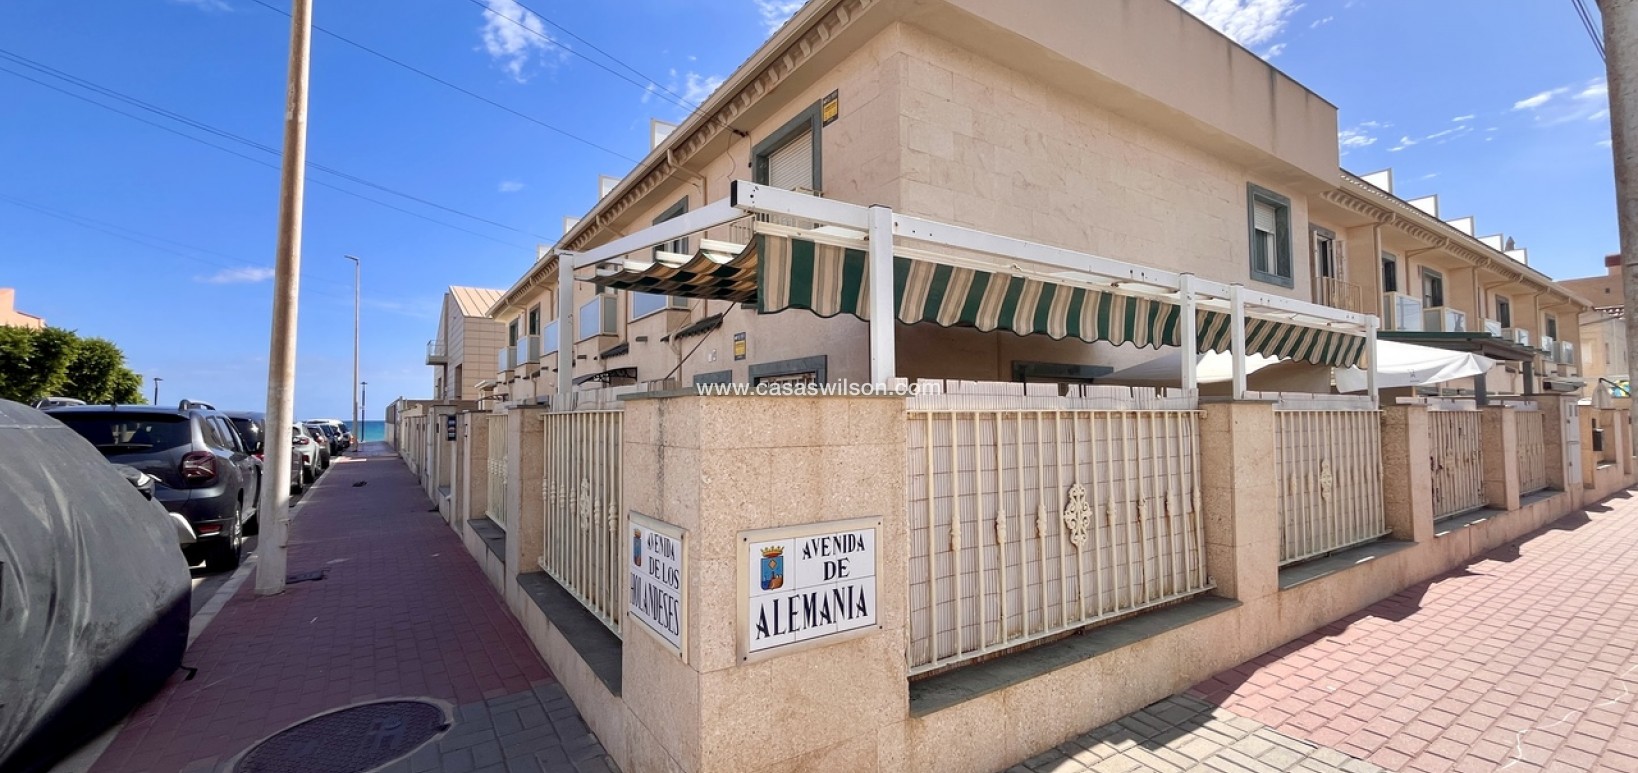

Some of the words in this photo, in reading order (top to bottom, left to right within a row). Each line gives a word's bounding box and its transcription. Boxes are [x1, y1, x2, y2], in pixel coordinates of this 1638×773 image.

[647, 533, 675, 562] AVENIDA
[802, 533, 866, 560] AVENIDA
[649, 556, 660, 580] DE
[662, 562, 679, 590] LOS
[823, 556, 851, 581] DE
[630, 572, 679, 636] HOLANDESES
[755, 584, 869, 640] ALEMANIA
